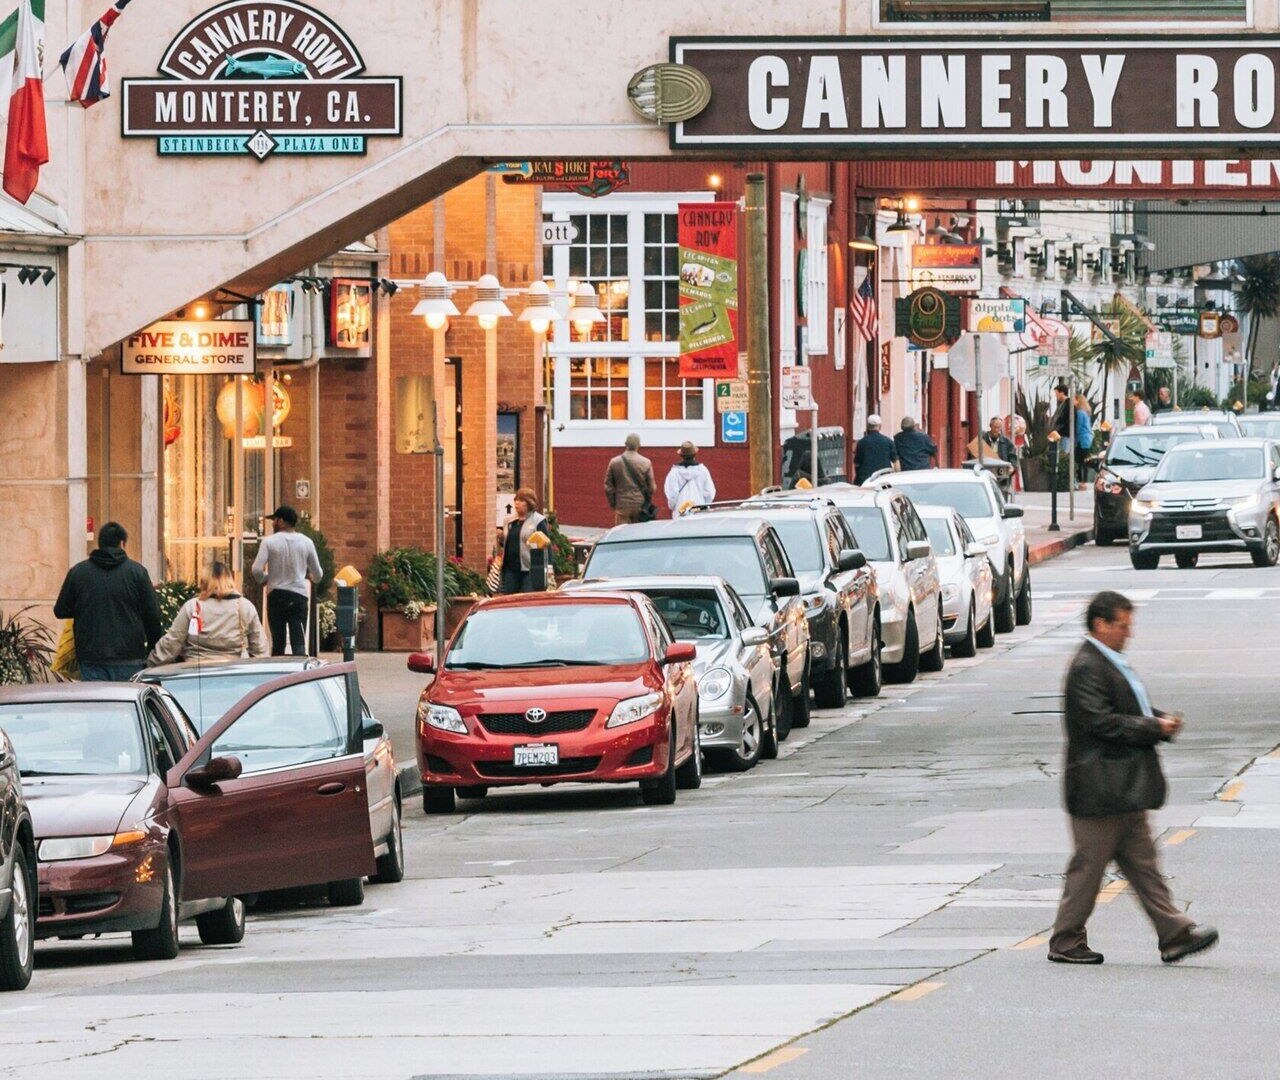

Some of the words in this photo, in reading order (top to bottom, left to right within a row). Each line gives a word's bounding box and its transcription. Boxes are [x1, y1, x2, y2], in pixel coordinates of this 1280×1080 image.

[178, 9, 295, 77] CANNERY
[291, 21, 349, 77] ROW
[747, 54, 1126, 130] CANNERY
[155, 91, 312, 126] MONTEREY,
[327, 91, 371, 122] CA.
[164, 139, 239, 152] STEINBECK
[284, 138, 325, 151] PLAZA
[332, 138, 360, 150] ONE
[683, 211, 733, 227] CANNERY
[695, 231, 720, 246] ROW
[128, 332, 175, 348] FIVE
[178, 332, 193, 348] &
[198, 332, 249, 348] DIME
[135, 354, 199, 364] GENERAL
[202, 354, 244, 364] STORE
[721, 385, 728, 396] 2
